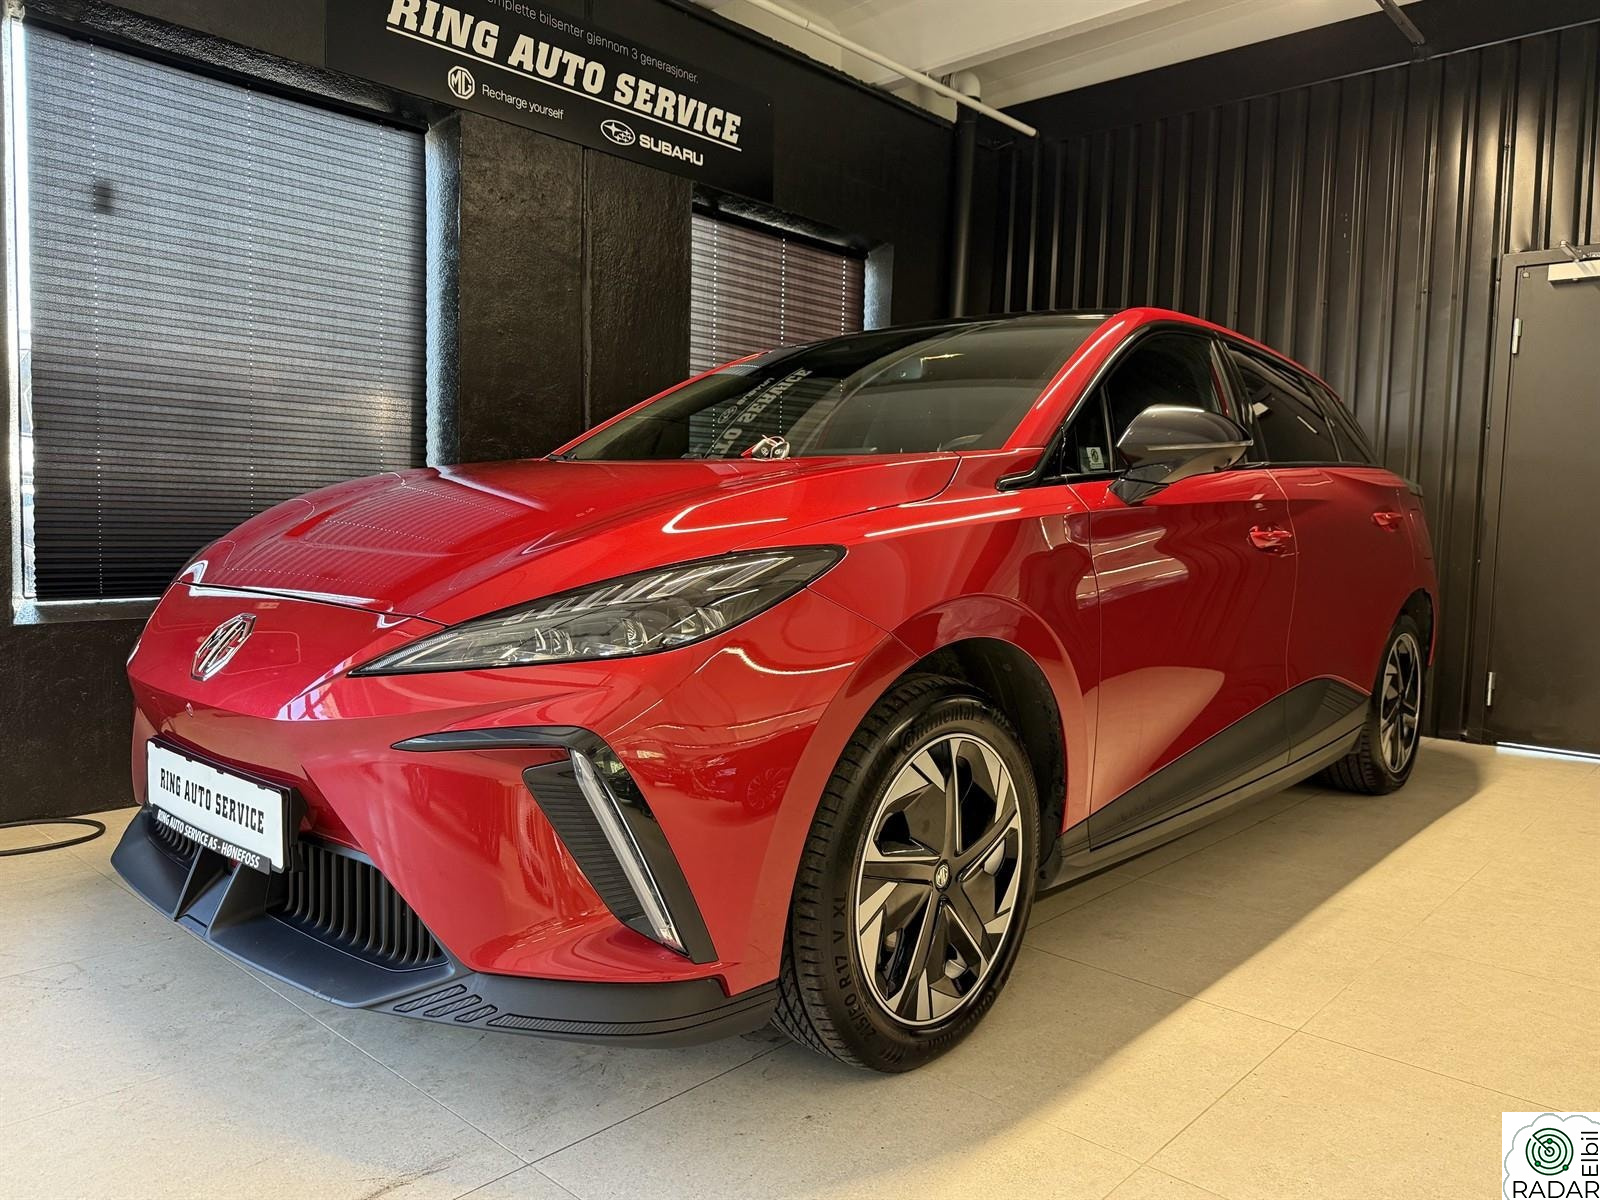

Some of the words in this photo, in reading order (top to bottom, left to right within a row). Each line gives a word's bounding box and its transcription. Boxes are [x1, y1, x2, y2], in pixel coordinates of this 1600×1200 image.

[386, 0, 500, 59] RING
[508, 33, 605, 95] AUTO
[613, 73, 742, 144] SERVICE
[539, 9, 584, 39] bilsenter
[586, 31, 630, 58] gjennom
[631, 47, 638, 60] 3
[640, 52, 699, 85] generasjoner.
[448, 66, 475, 99] MG
[482, 83, 528, 110] Recharge
[528, 101, 564, 121] yourself
[639, 133, 704, 166] SUBARU
[193, 614, 253, 679] MG
[160, 768, 181, 797] RING
[184, 780, 212, 811] AUTO
[215, 793, 265, 834] SERVICE
[157, 809, 170, 826] RING
[168, 817, 184, 834] AUTO
[184, 825, 208, 847] SERVICE
[208, 836, 218, 850] AS
[221, 841, 260, 868] HØNEFOSS
[832, 929, 846, 944] V
